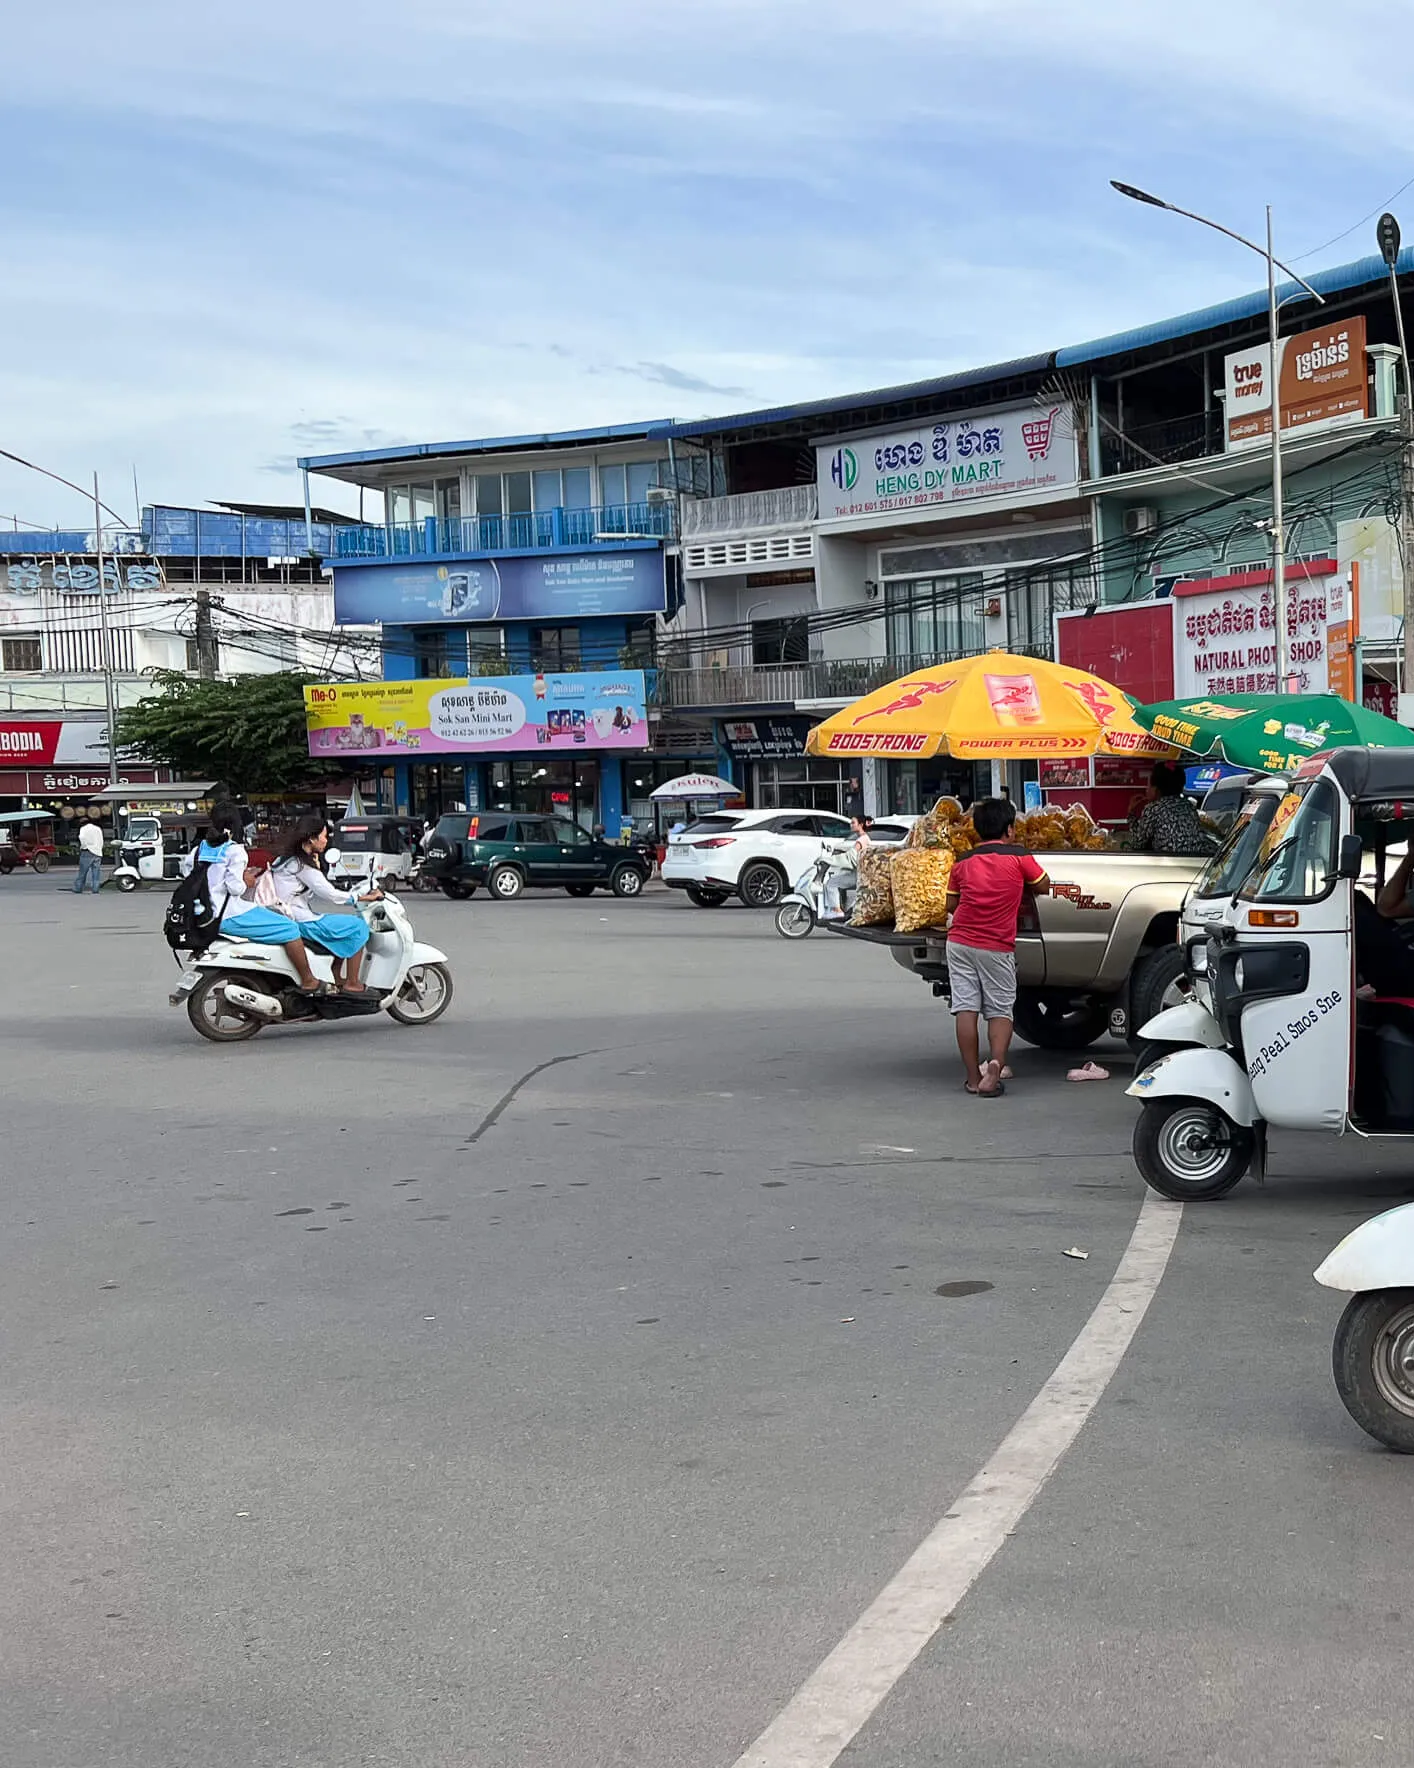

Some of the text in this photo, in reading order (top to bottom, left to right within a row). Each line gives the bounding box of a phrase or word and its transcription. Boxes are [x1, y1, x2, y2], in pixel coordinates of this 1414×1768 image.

[1233, 362, 1262, 383] true
[1235, 380, 1263, 398] money
[875, 423, 1002, 472] ហេង ឌី ម៉ាត
[876, 475, 920, 497] HENG
[924, 470, 946, 490] DY
[952, 459, 1004, 484] MART
[849, 504, 863, 514] 012
[879, 500, 893, 510] 575
[899, 497, 912, 507] 017
[1194, 640, 1322, 673] NATURAL PHOT SHOP
[311, 688, 337, 702] Me-O
[438, 712, 513, 724] Sok San Mini Mart
[1154, 714, 1200, 734] GOOD TIME
[0, 731, 43, 751] BODIA
[827, 733, 929, 752] BOOSTRONG
[959, 739, 1057, 750] POWER PLUS
[1172, 730, 1195, 747] TIME
[1260, 1032, 1290, 1063] Peal
[1287, 1010, 1319, 1039] Smos
[1316, 990, 1342, 1014] Sne
